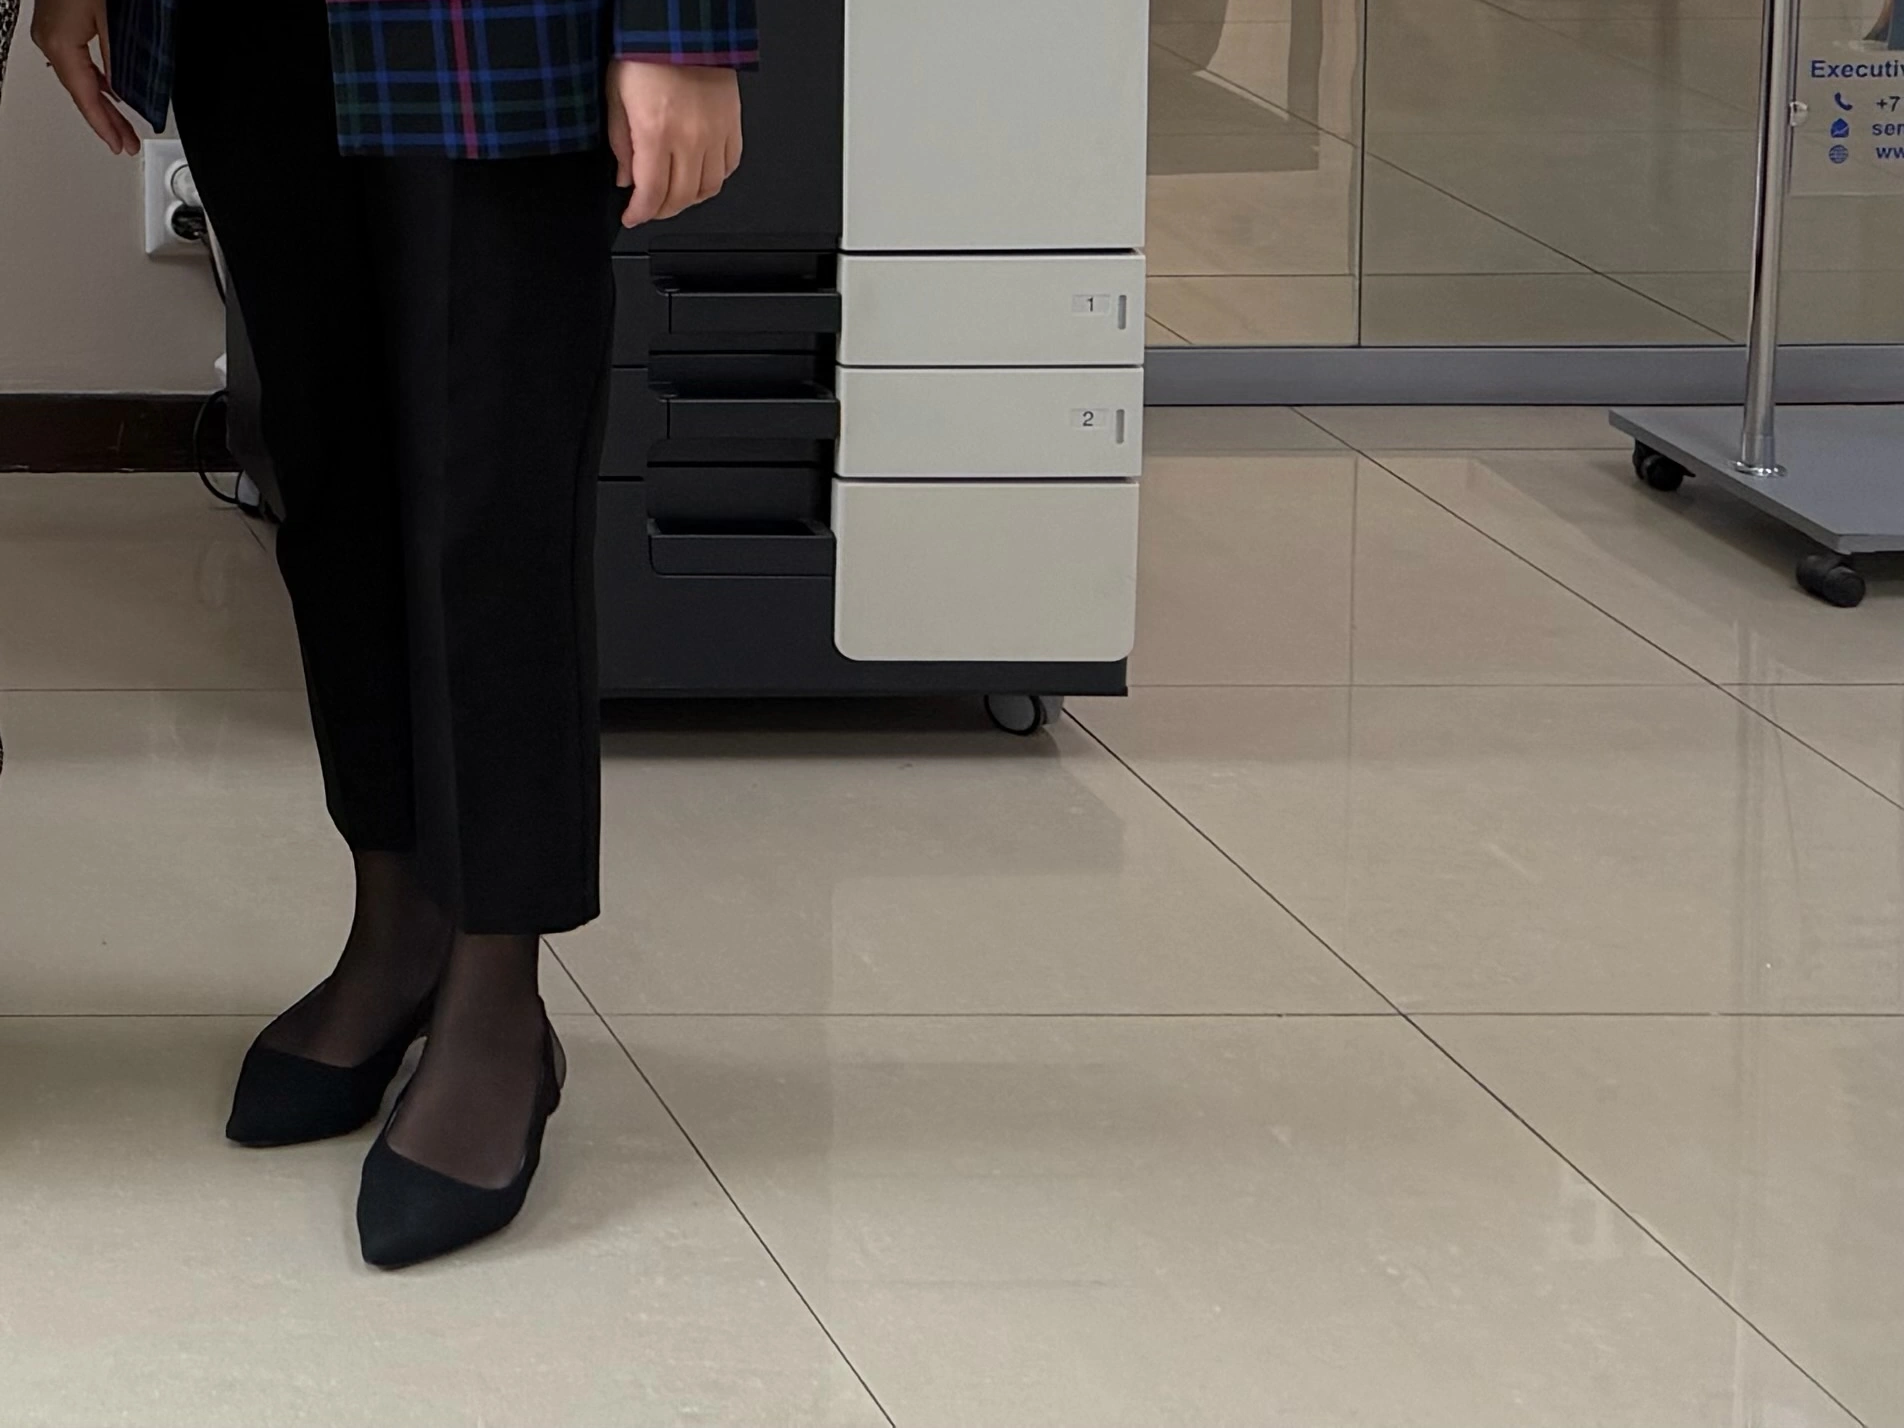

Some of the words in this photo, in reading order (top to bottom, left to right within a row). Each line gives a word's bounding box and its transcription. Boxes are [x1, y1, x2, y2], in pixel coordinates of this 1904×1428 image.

[1877, 96, 1900, 112] +7
[1086, 297, 1094, 312] 1
[1082, 411, 1094, 427] 2
